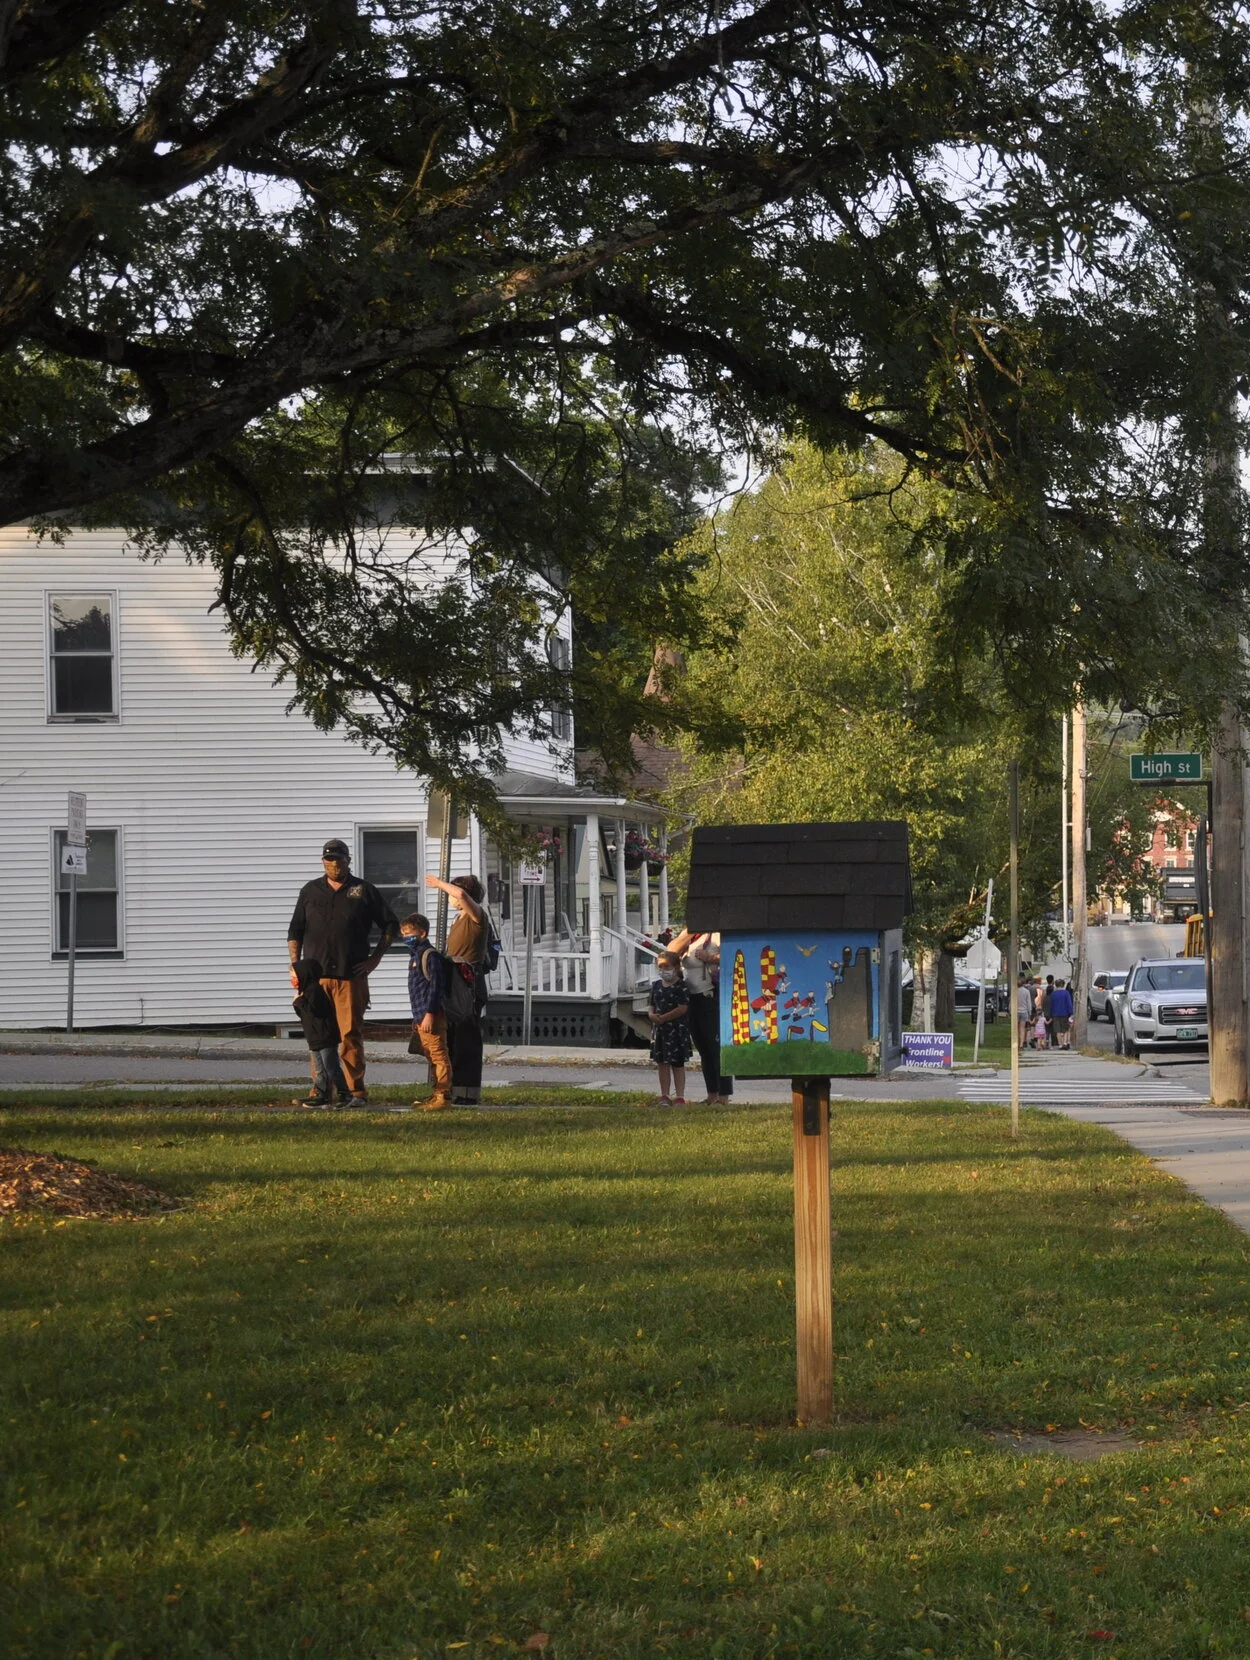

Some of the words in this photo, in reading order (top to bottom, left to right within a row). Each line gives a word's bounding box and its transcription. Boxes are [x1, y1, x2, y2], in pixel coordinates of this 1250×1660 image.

[1141, 760, 1172, 777] High
[1178, 762, 1191, 773] St
[1175, 1007, 1198, 1016] GMC
[904, 1035, 933, 1044] THANK
[933, 1036, 952, 1045] YOU
